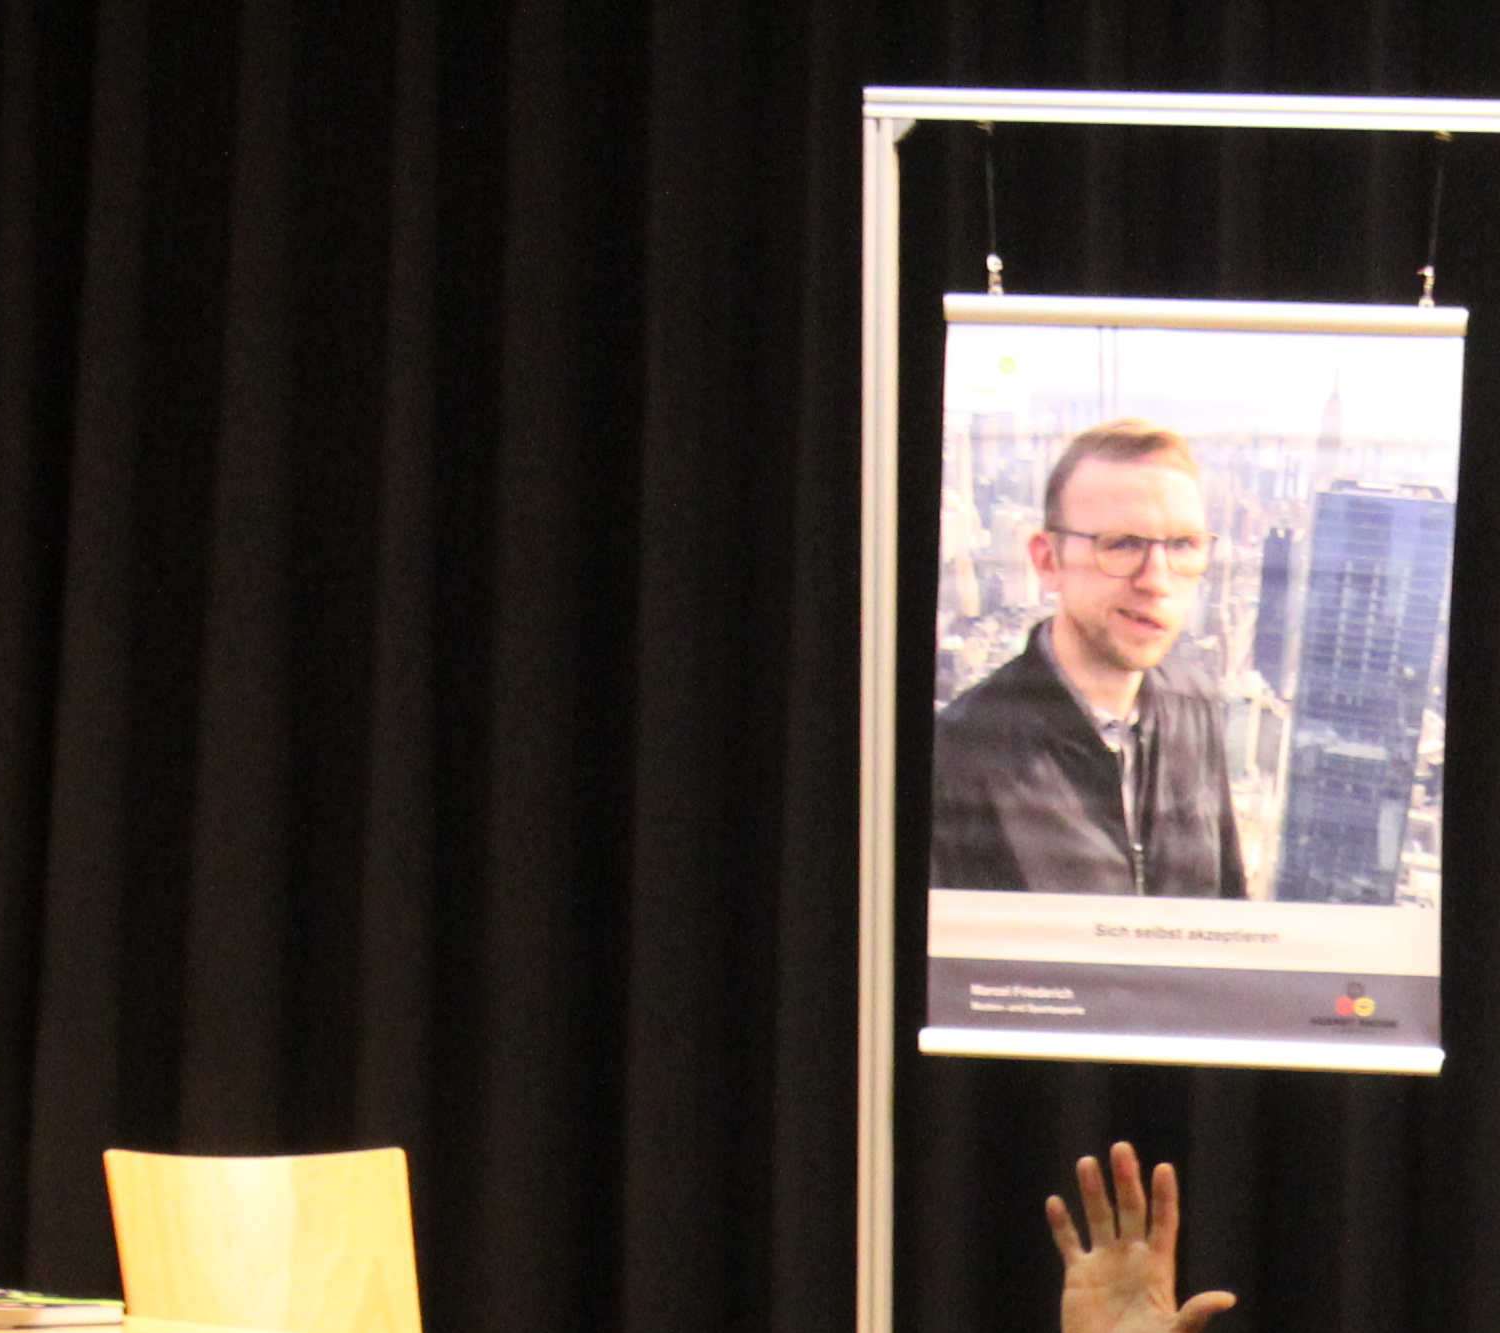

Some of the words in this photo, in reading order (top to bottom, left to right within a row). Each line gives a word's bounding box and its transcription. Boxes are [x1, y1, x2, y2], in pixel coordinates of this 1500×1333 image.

[1095, 924, 1128, 939] Sich
[1135, 925, 1182, 941] selbst
[1188, 927, 1280, 945] akzeptieren
